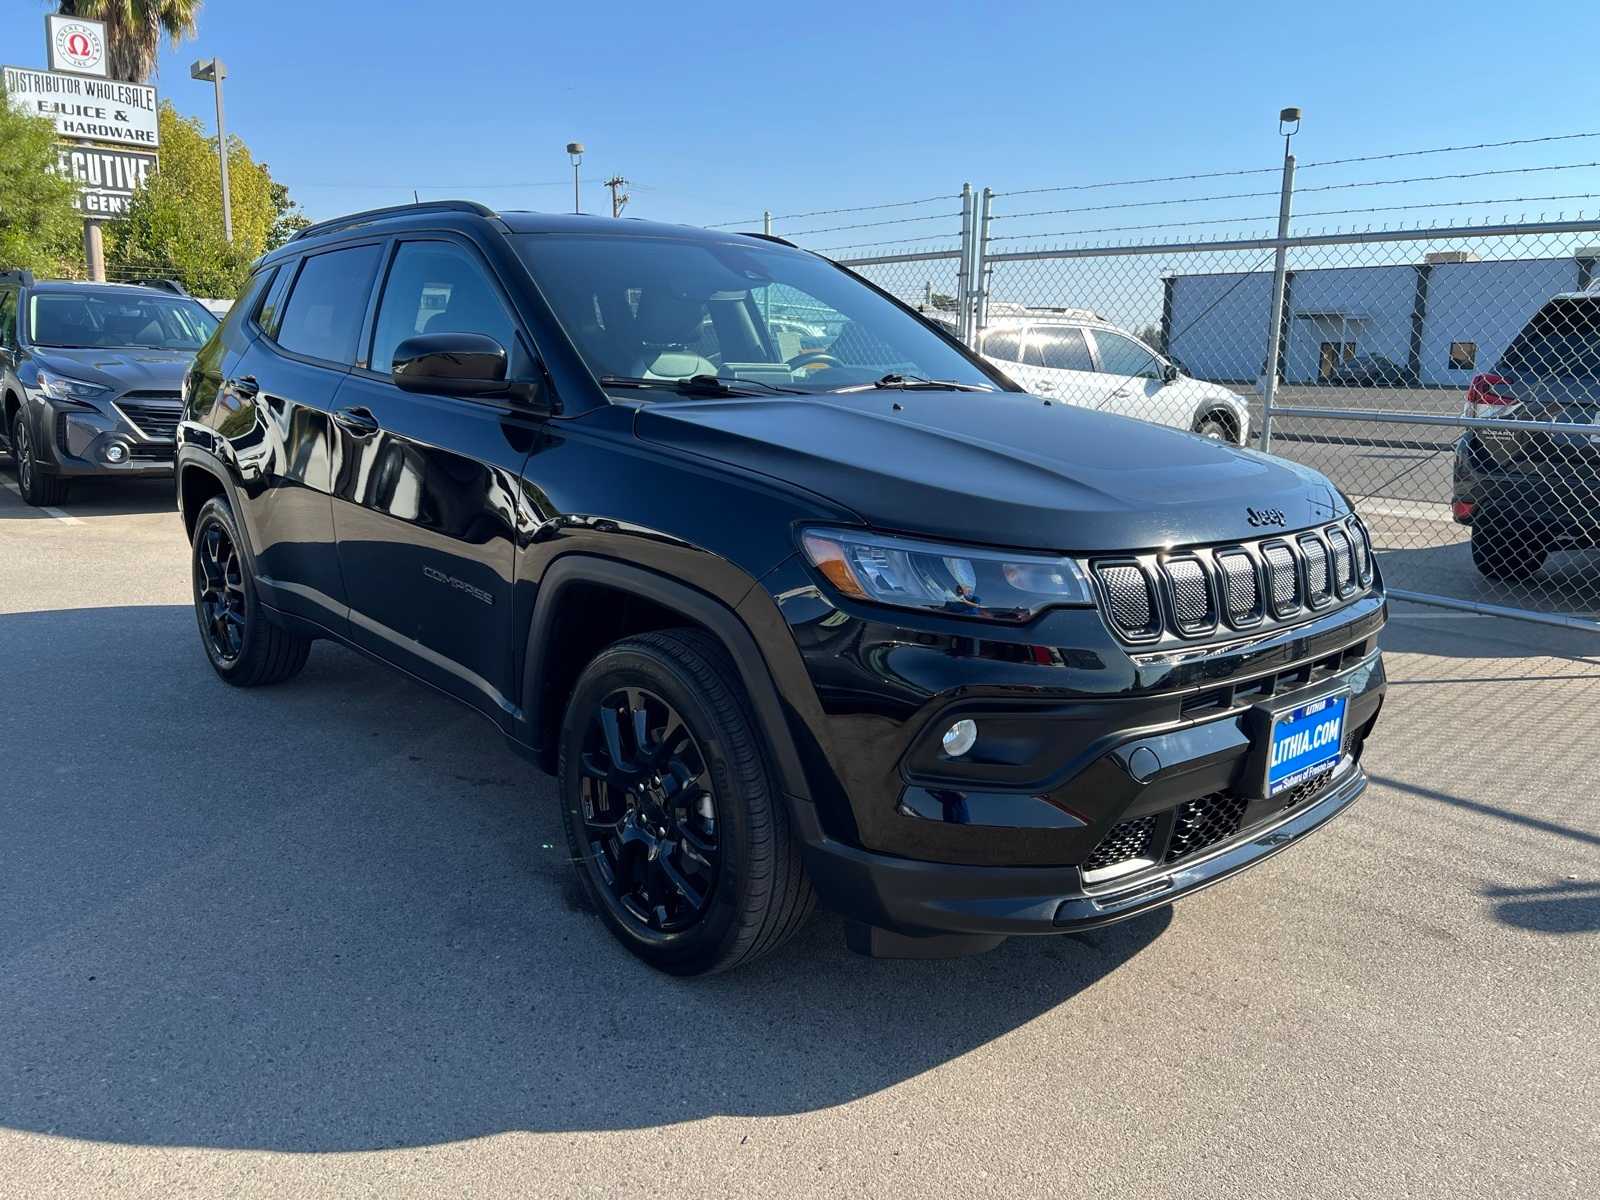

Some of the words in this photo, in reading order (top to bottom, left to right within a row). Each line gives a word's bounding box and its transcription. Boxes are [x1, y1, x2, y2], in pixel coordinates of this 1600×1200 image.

[8, 71, 81, 97] DISTRIBUTOR
[84, 80, 153, 112] WHOLESALE
[37, 100, 107, 119] EJUICE
[114, 110, 130, 122] &
[63, 120, 155, 143] HARDWARE
[1246, 507, 1286, 527] Jeep
[423, 567, 493, 605] COMPASS
[1270, 717, 1340, 768] LITHIA.COM
